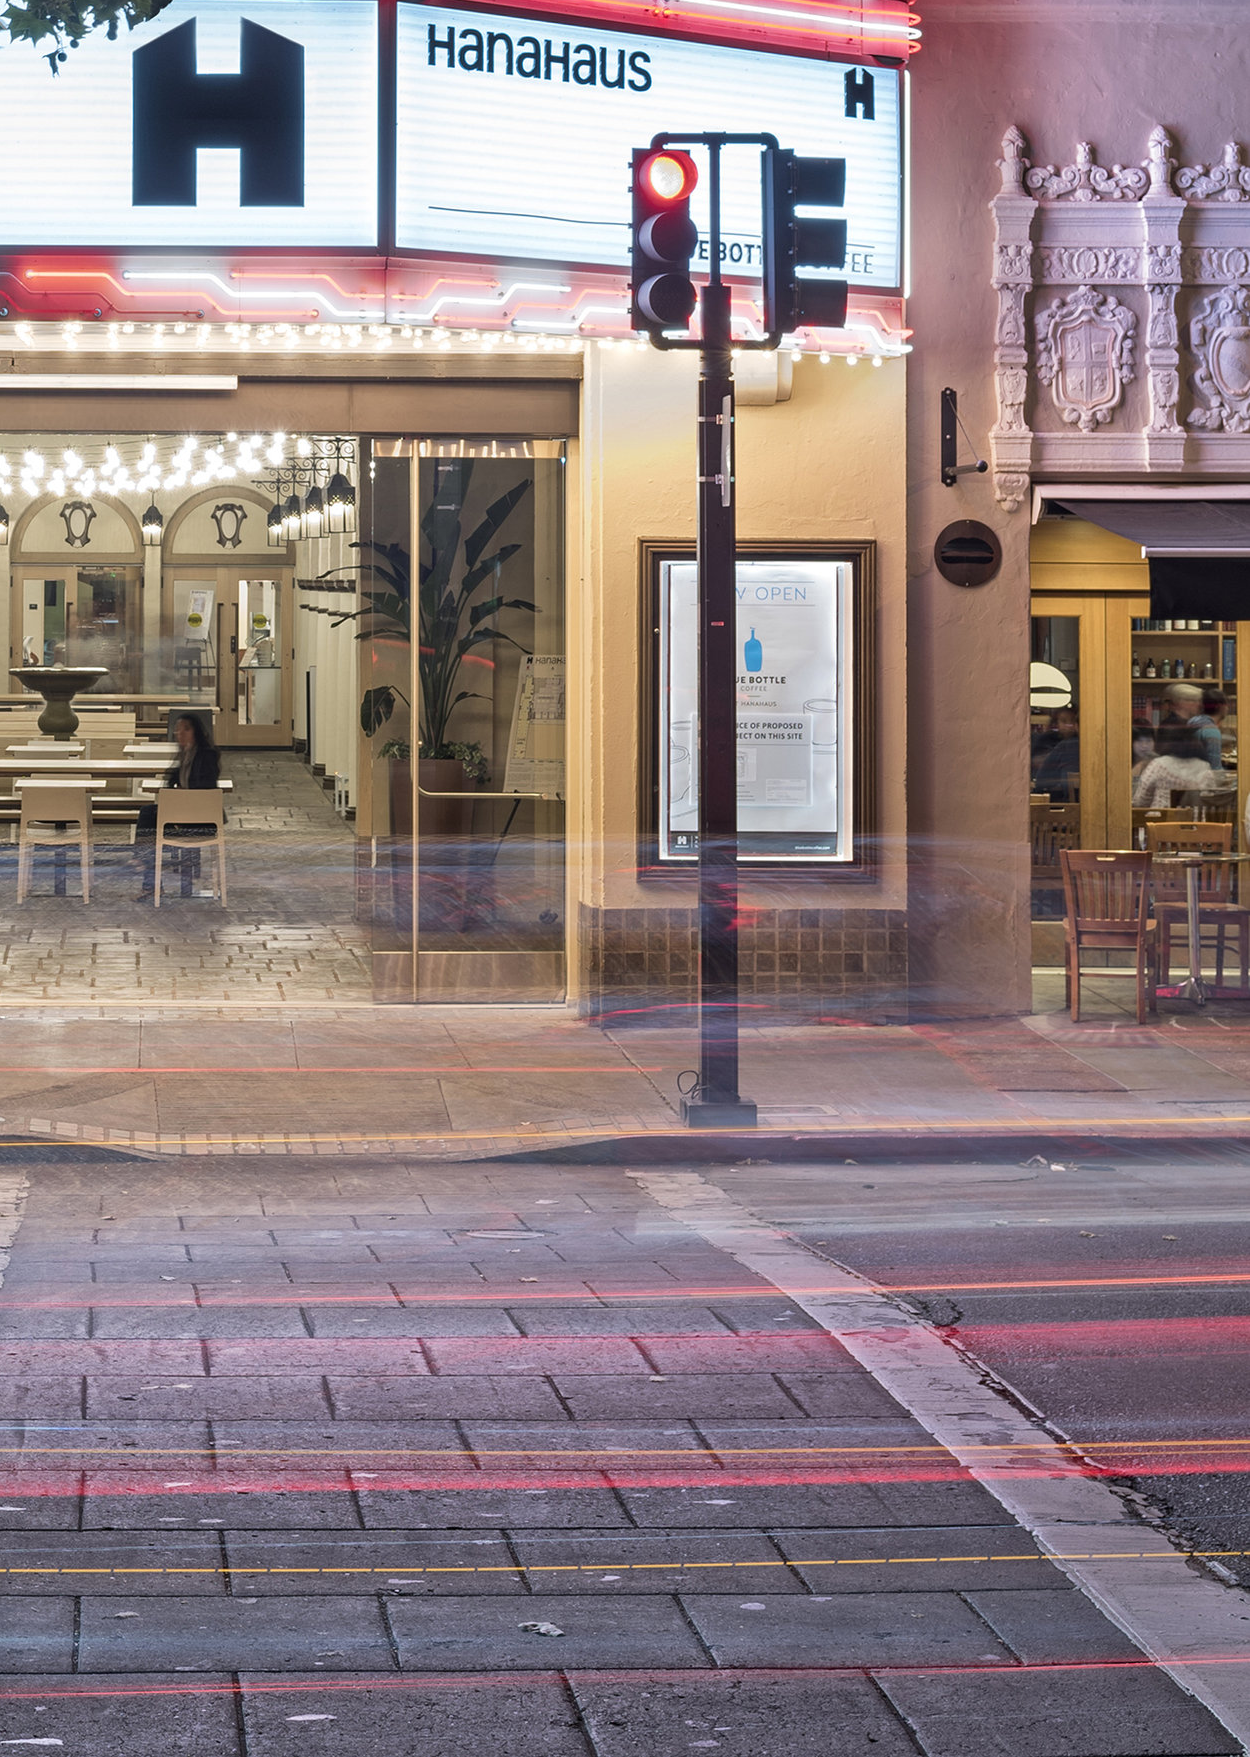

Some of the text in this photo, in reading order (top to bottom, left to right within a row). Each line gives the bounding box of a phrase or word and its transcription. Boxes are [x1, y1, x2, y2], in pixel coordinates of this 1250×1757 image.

[132, 16, 306, 208] H
[755, 586, 808, 601] OPEN
[749, 676, 787, 684] BOTTLE
[750, 722, 761, 730] OF
[762, 722, 803, 730] PROPOSED
[754, 732, 767, 740] ON
[768, 732, 785, 740] THIS
[787, 732, 803, 740] SITE
